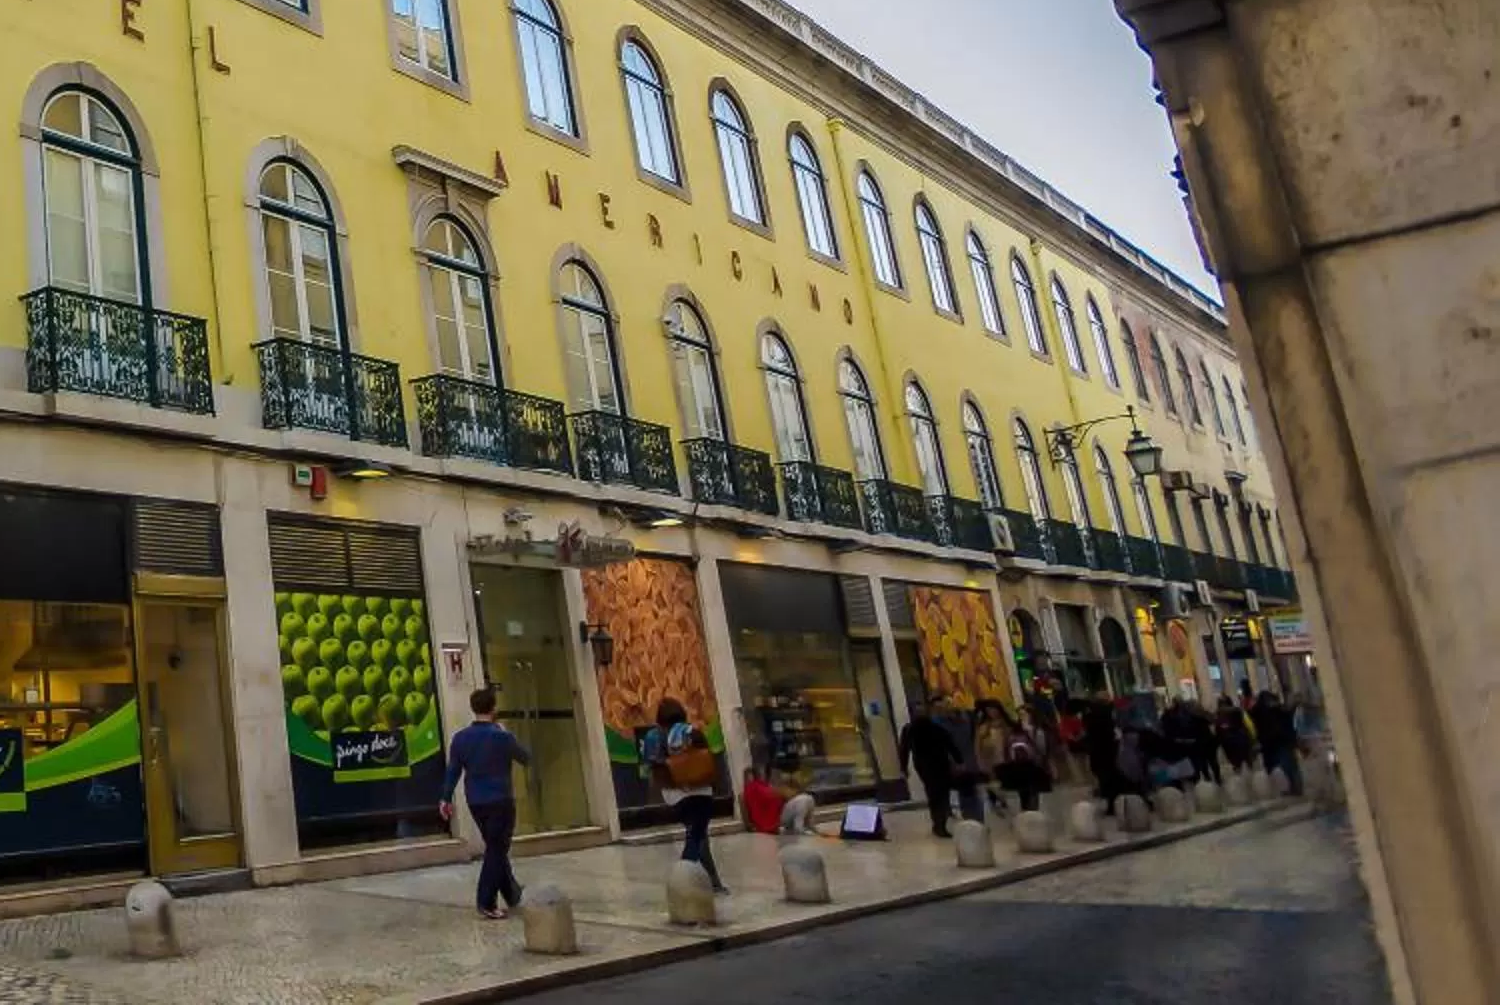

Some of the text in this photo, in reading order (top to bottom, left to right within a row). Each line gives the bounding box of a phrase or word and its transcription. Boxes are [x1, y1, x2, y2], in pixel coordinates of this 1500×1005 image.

[494, 149, 854, 326] AMERICANO
[336, 741, 369, 768] pingo
[371, 734, 398, 751] doce
